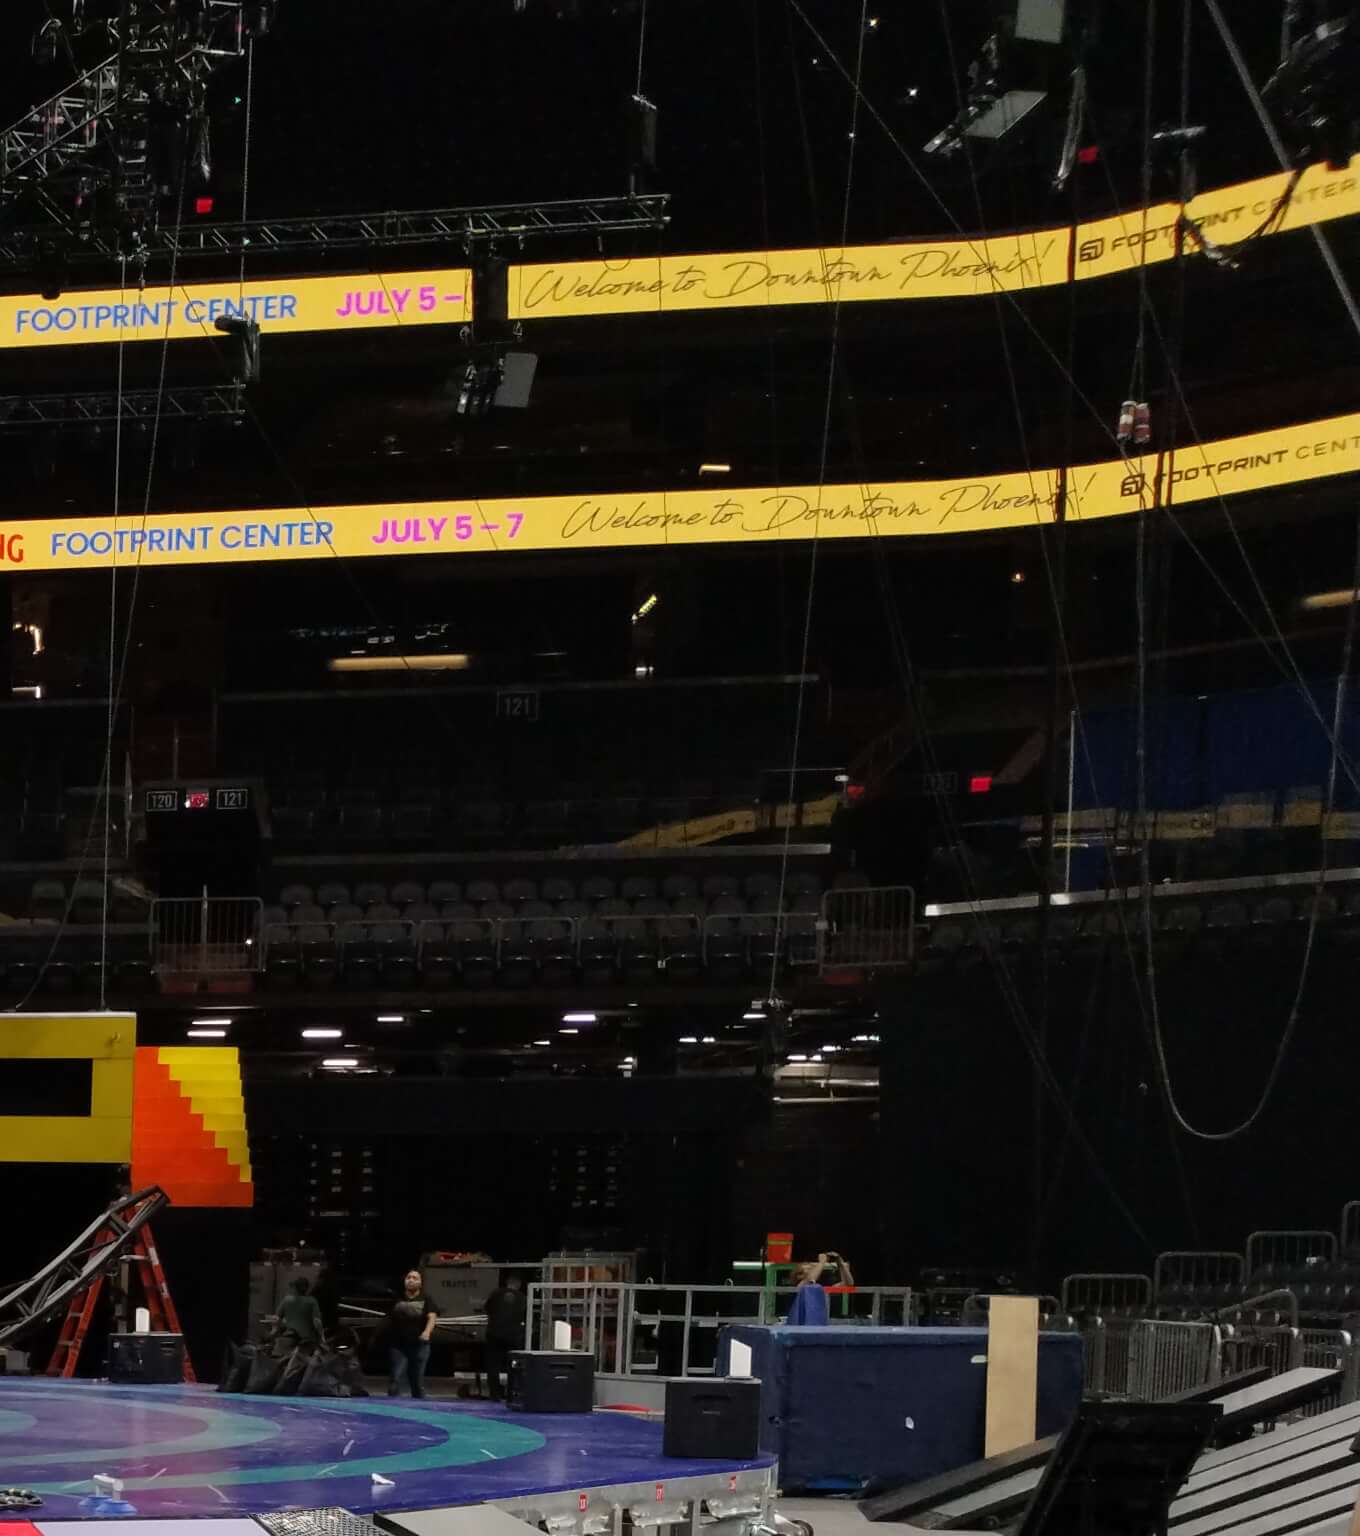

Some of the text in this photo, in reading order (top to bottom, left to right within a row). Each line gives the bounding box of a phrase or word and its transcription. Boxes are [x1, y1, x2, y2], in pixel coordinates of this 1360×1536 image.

[525, 265, 666, 308] Welcome
[667, 263, 705, 291] to
[705, 259, 889, 296] Downtown
[15, 294, 297, 333] FOOTPRINT CENTER
[336, 289, 413, 317] JULY
[372, 518, 449, 544] JULY
[562, 502, 704, 538] Welcome
[704, 503, 743, 527] to
[743, 497, 931, 532] Downtown
[51, 522, 334, 556] FOOTPRINT CENTER
[504, 696, 529, 716] 121
[223, 792, 243, 807] 121
